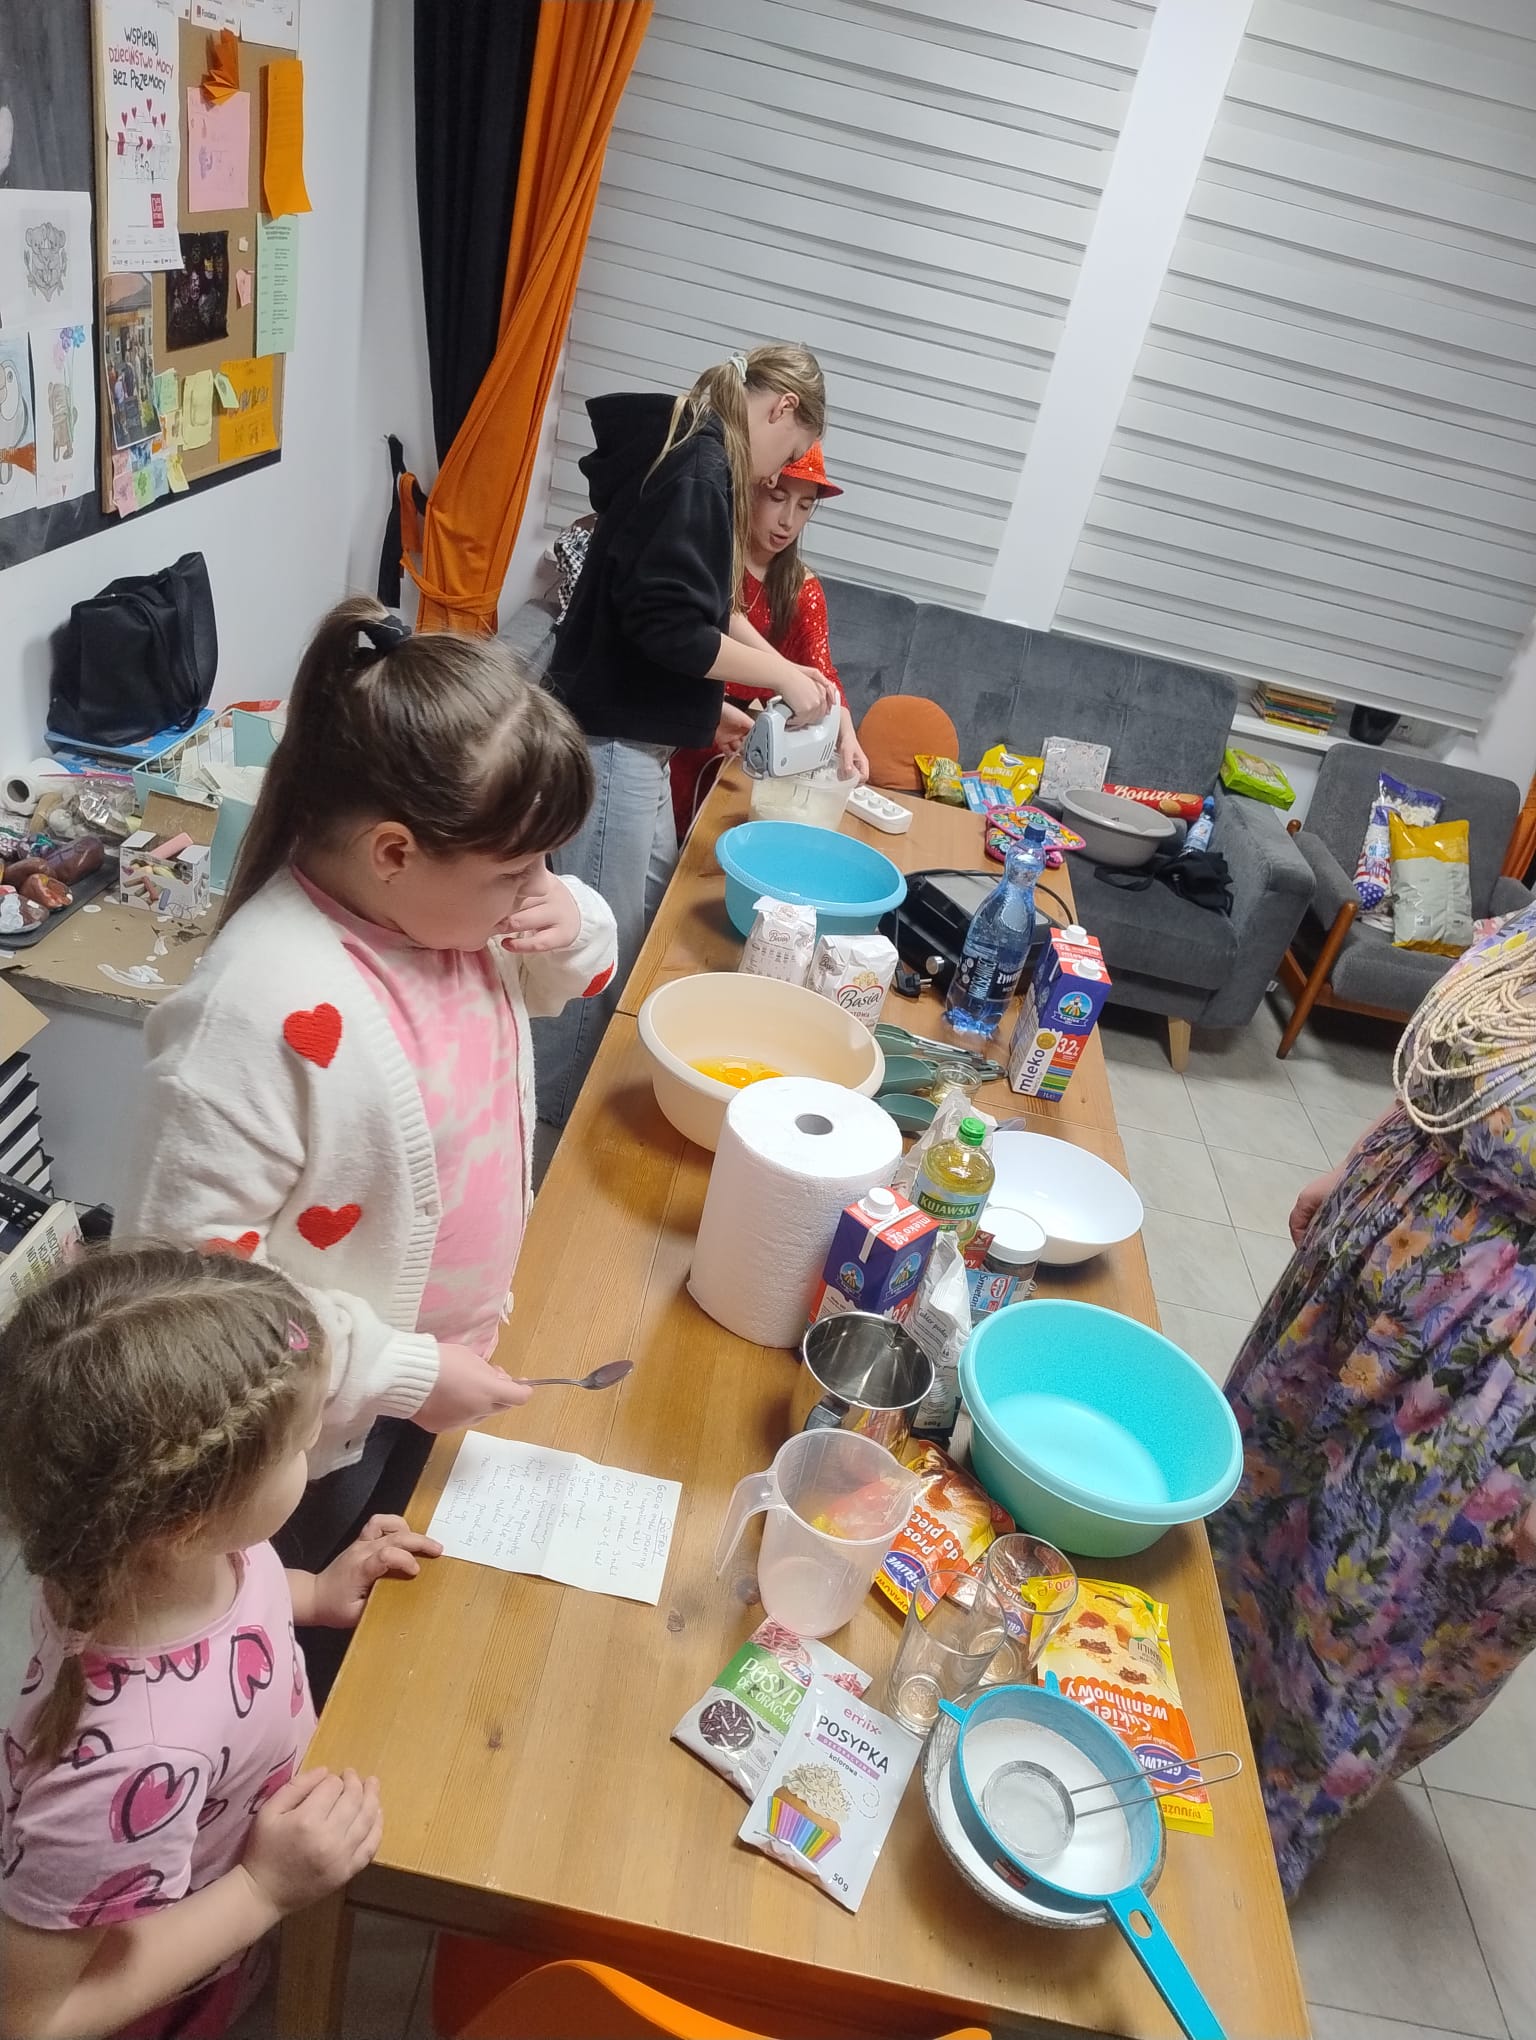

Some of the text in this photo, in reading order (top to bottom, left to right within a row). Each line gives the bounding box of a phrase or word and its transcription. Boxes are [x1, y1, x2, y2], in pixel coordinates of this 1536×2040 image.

[156, 58, 174, 80] MOCY
[1114, 785, 1180, 802] Bonitki
[839, 989, 880, 1009] Basia
[1019, 1049, 1045, 1092] mleko
[920, 1196, 977, 1216] KUJAWSKI
[903, 1216, 931, 1234] mleko
[903, 1526, 936, 1555] Pros
[943, 1539, 959, 1560] do
[739, 1657, 803, 1711] POSYP
[1065, 1681, 1168, 1721] wanilinowy
[844, 1708, 879, 1735] emix
[1094, 1706, 1151, 1731] Cukier
[816, 1715, 889, 1774] POSYPKA
[829, 1752, 858, 1776] kolorowa
[1139, 1754, 1182, 1776] GELLWE
